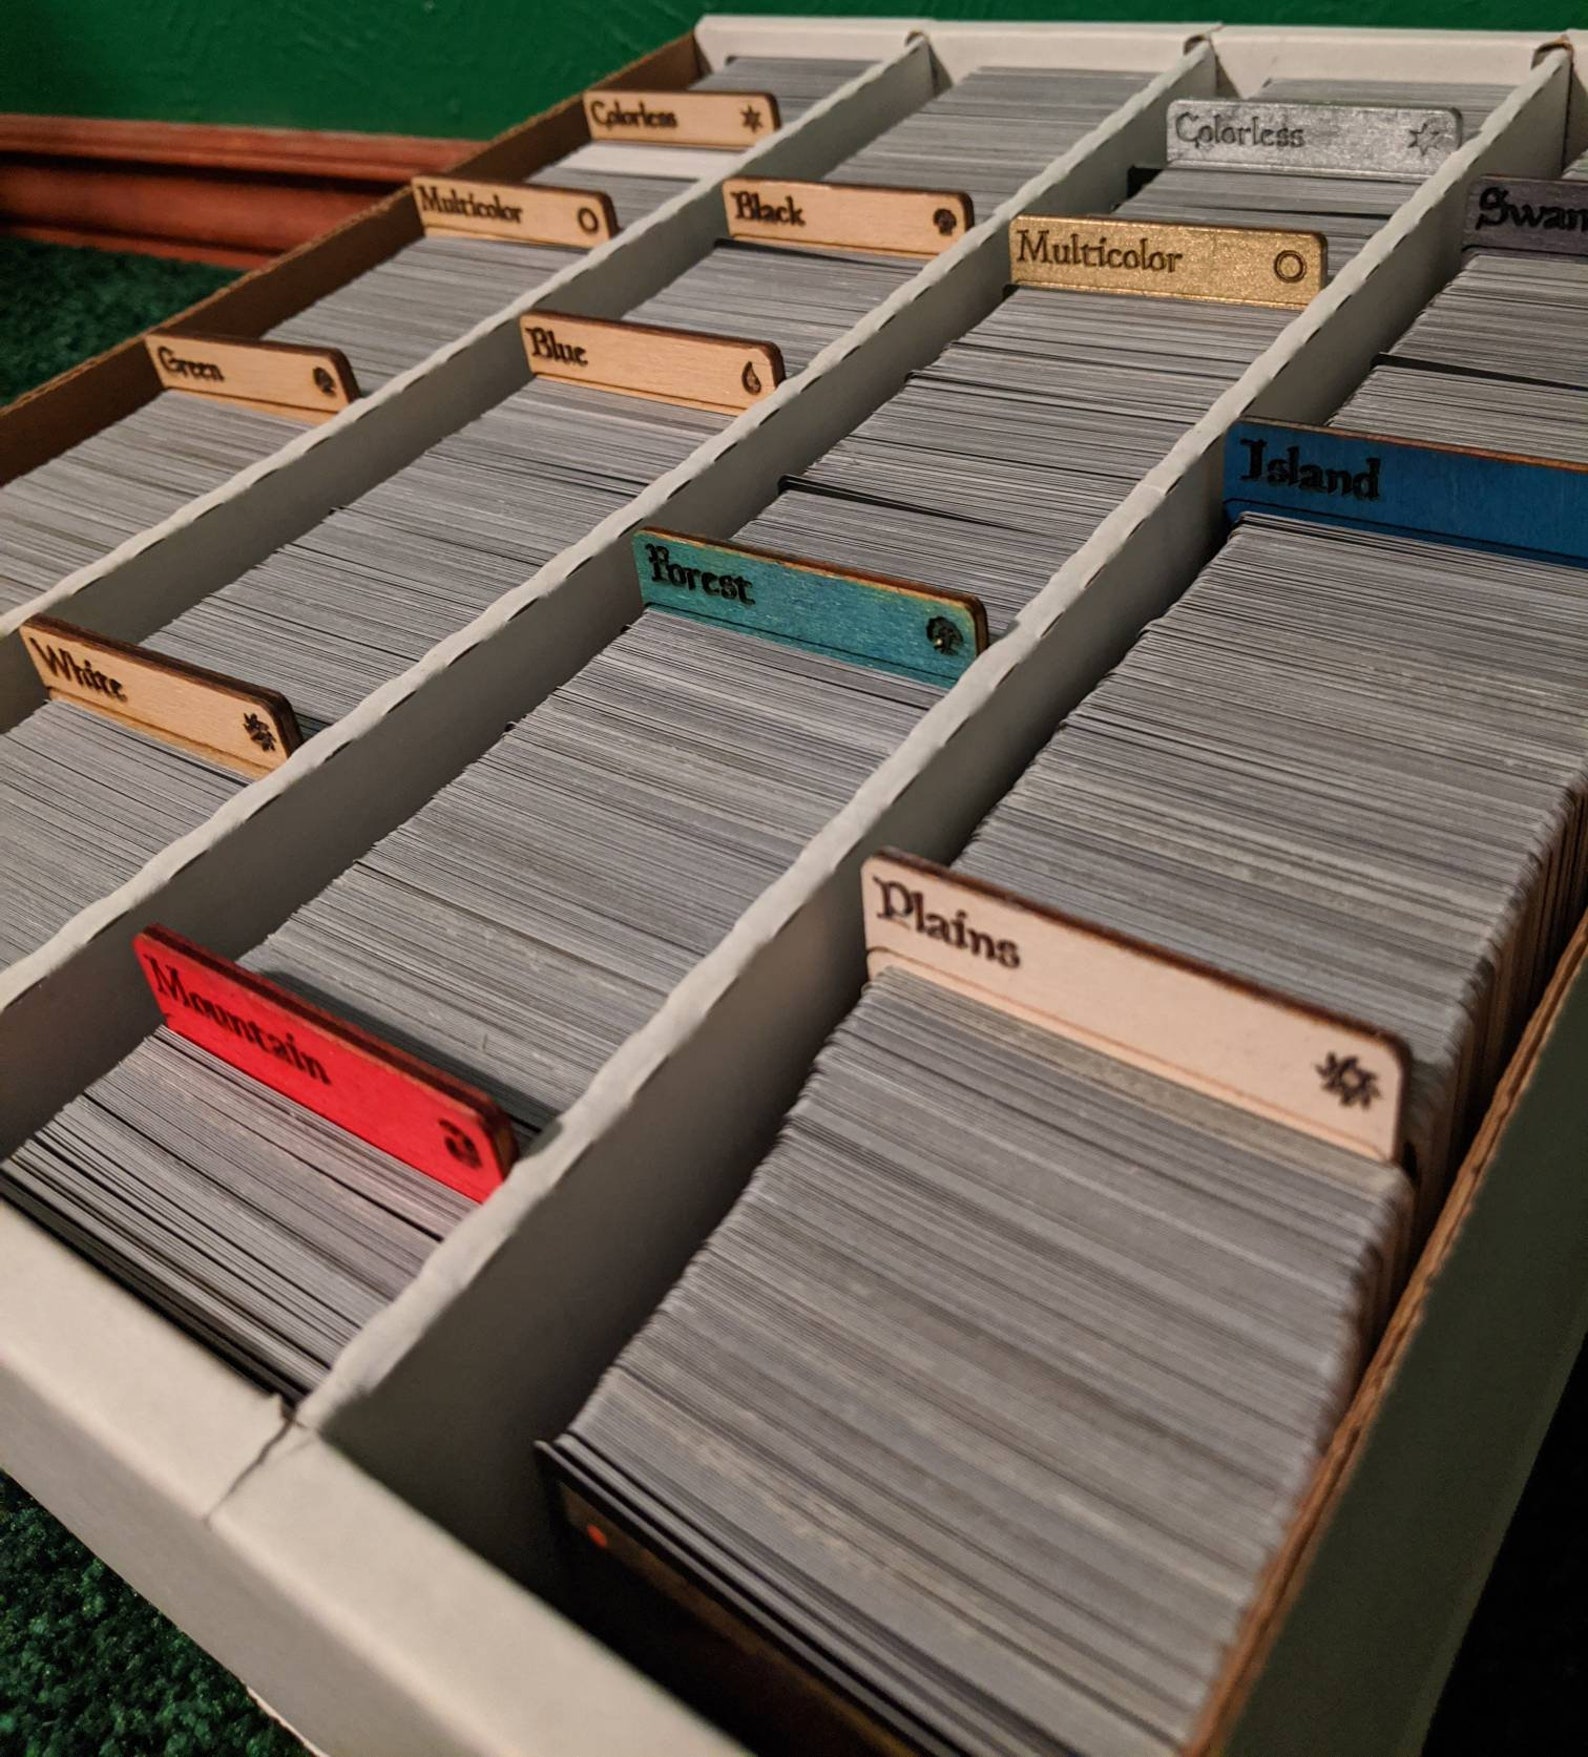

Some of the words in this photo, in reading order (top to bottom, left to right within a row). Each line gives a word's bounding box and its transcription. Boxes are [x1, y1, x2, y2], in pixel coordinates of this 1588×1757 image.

[590, 100, 679, 131] Colorless
[1174, 111, 1306, 148] Colorless
[417, 185, 523, 223] Multicolor
[730, 191, 806, 227] Black
[1016, 229, 1184, 273] Multicolor
[158, 346, 225, 382] Green
[525, 326, 588, 366] Blue
[1239, 438, 1382, 500] Island
[645, 543, 756, 605] Forest
[29, 637, 127, 702] White
[872, 875, 1021, 969] Plains
[143, 953, 332, 1085] Mountain
